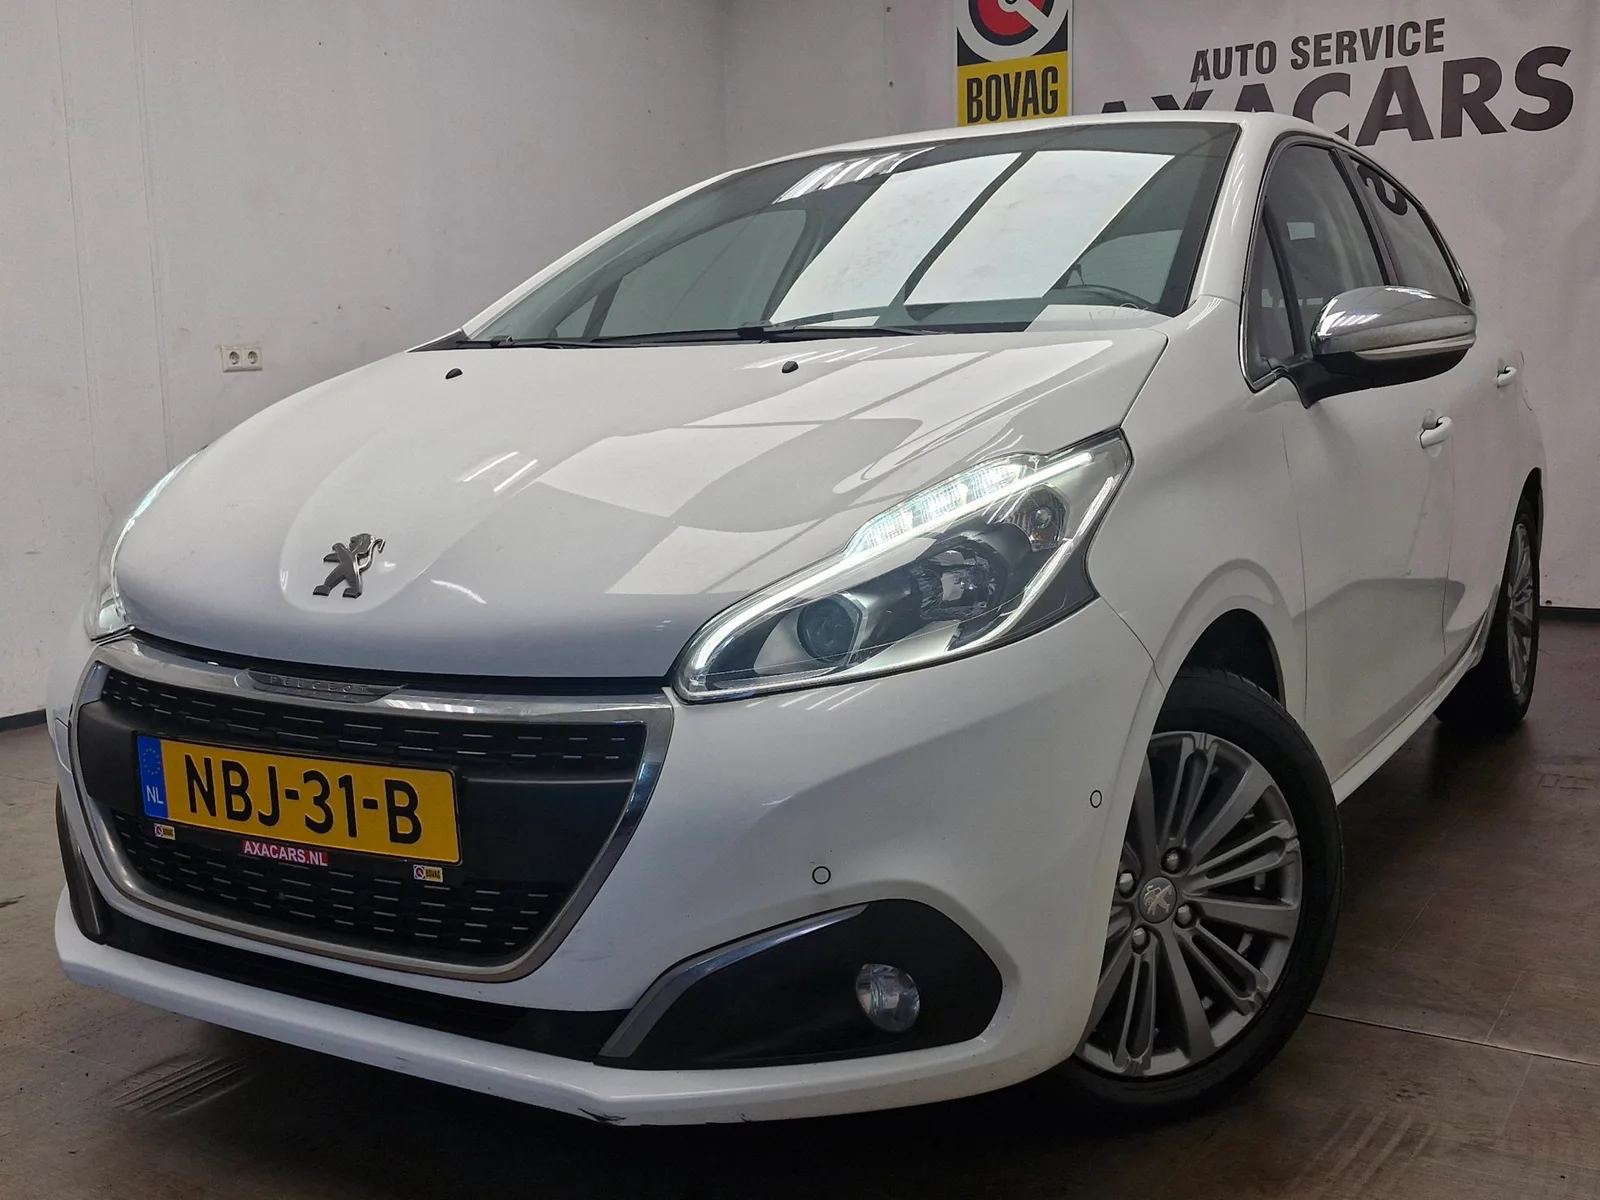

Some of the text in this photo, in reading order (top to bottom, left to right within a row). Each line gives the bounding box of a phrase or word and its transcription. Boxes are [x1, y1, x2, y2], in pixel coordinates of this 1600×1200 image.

[1190, 18, 1446, 83] AUTO SERVICE
[966, 67, 1059, 125] BOVAG
[1101, 46, 1574, 147] CARS
[146, 753, 423, 844] NL NBJ-31-B
[243, 841, 328, 867] AXACARS.NL
